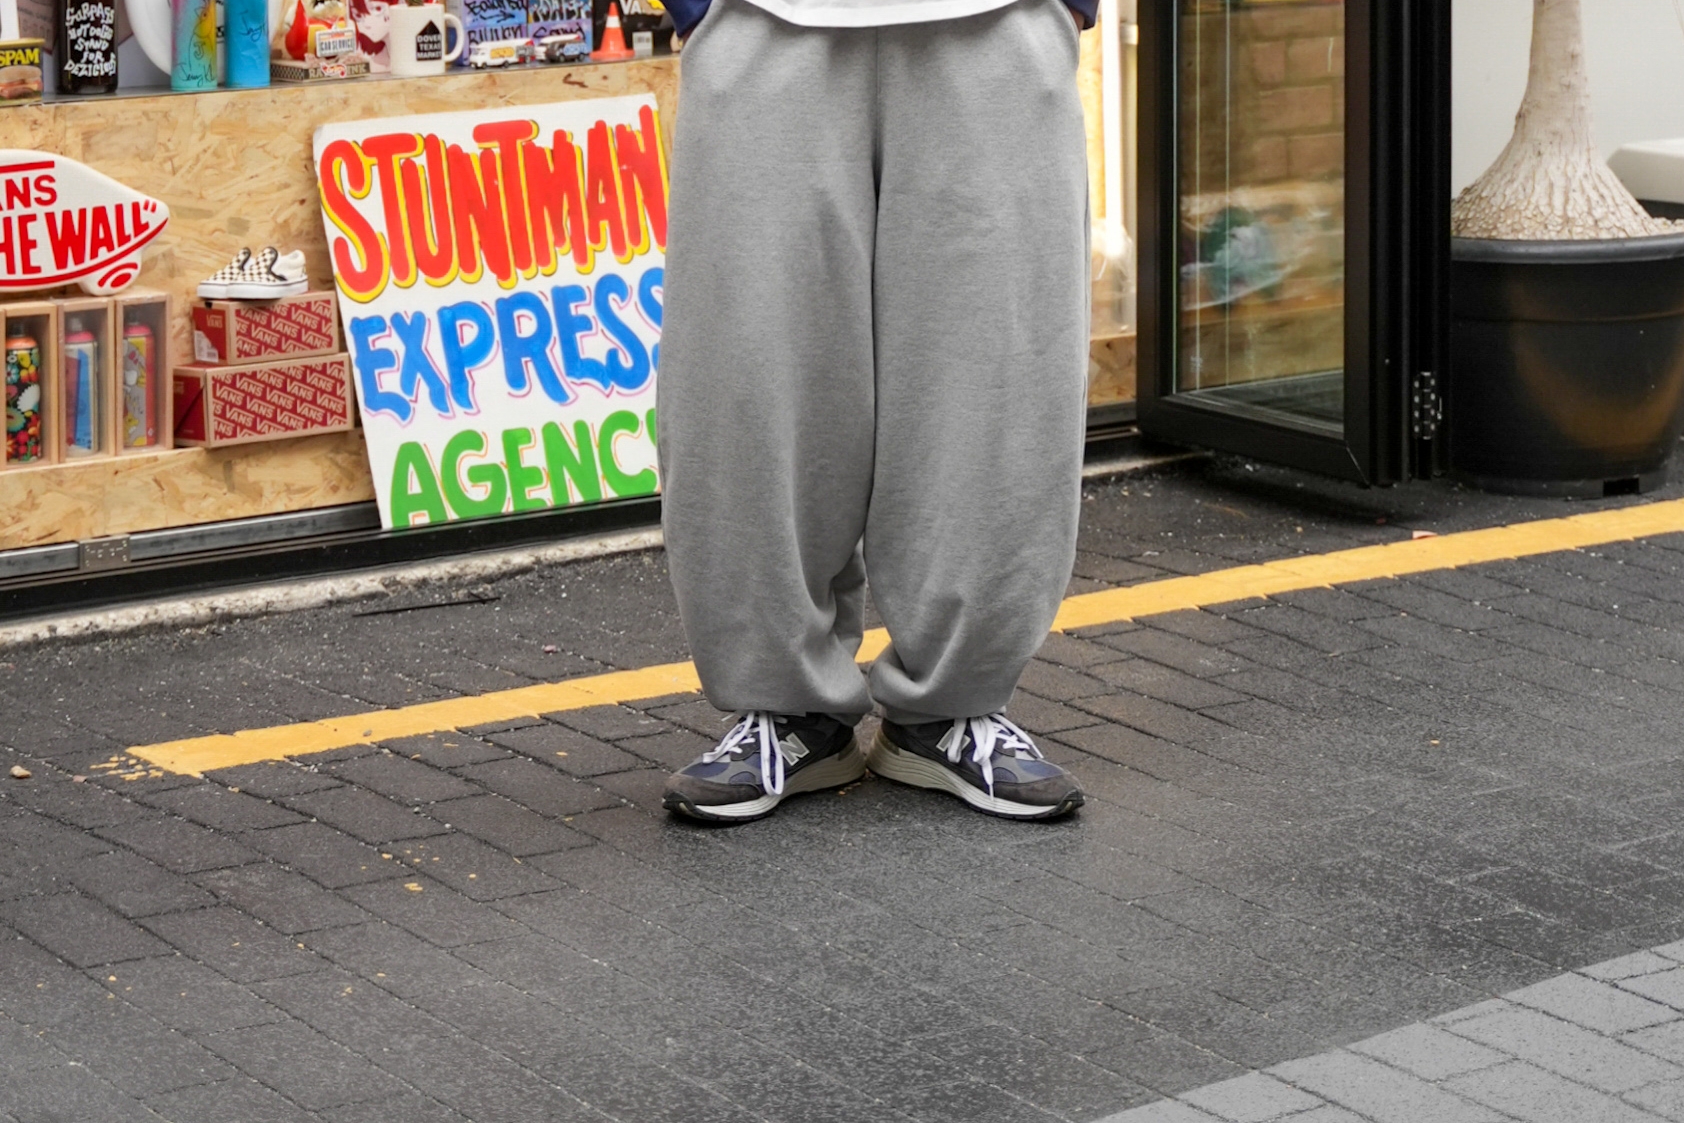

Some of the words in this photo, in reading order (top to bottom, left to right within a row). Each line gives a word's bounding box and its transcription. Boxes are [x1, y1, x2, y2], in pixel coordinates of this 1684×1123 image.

[74, 37, 109, 51] STAND
[80, 50, 105, 64] FOR
[319, 103, 669, 304] STUNTMAN
[0, 213, 41, 275] HE
[271, 314, 300, 338] VANS
[291, 307, 320, 329] VANS
[251, 323, 280, 347] VANS
[306, 368, 335, 392] VANS
[216, 382, 245, 405] VANS
[247, 395, 276, 418] VANS
[236, 374, 265, 397] VANS
[266, 386, 295, 409] VANS
[297, 399, 325, 422] VANS
[287, 378, 315, 401] VANS
[317, 390, 346, 413] VANS
[226, 404, 255, 427] VANS
[390, 408, 658, 529] AGENC
[779, 733, 810, 765] N
